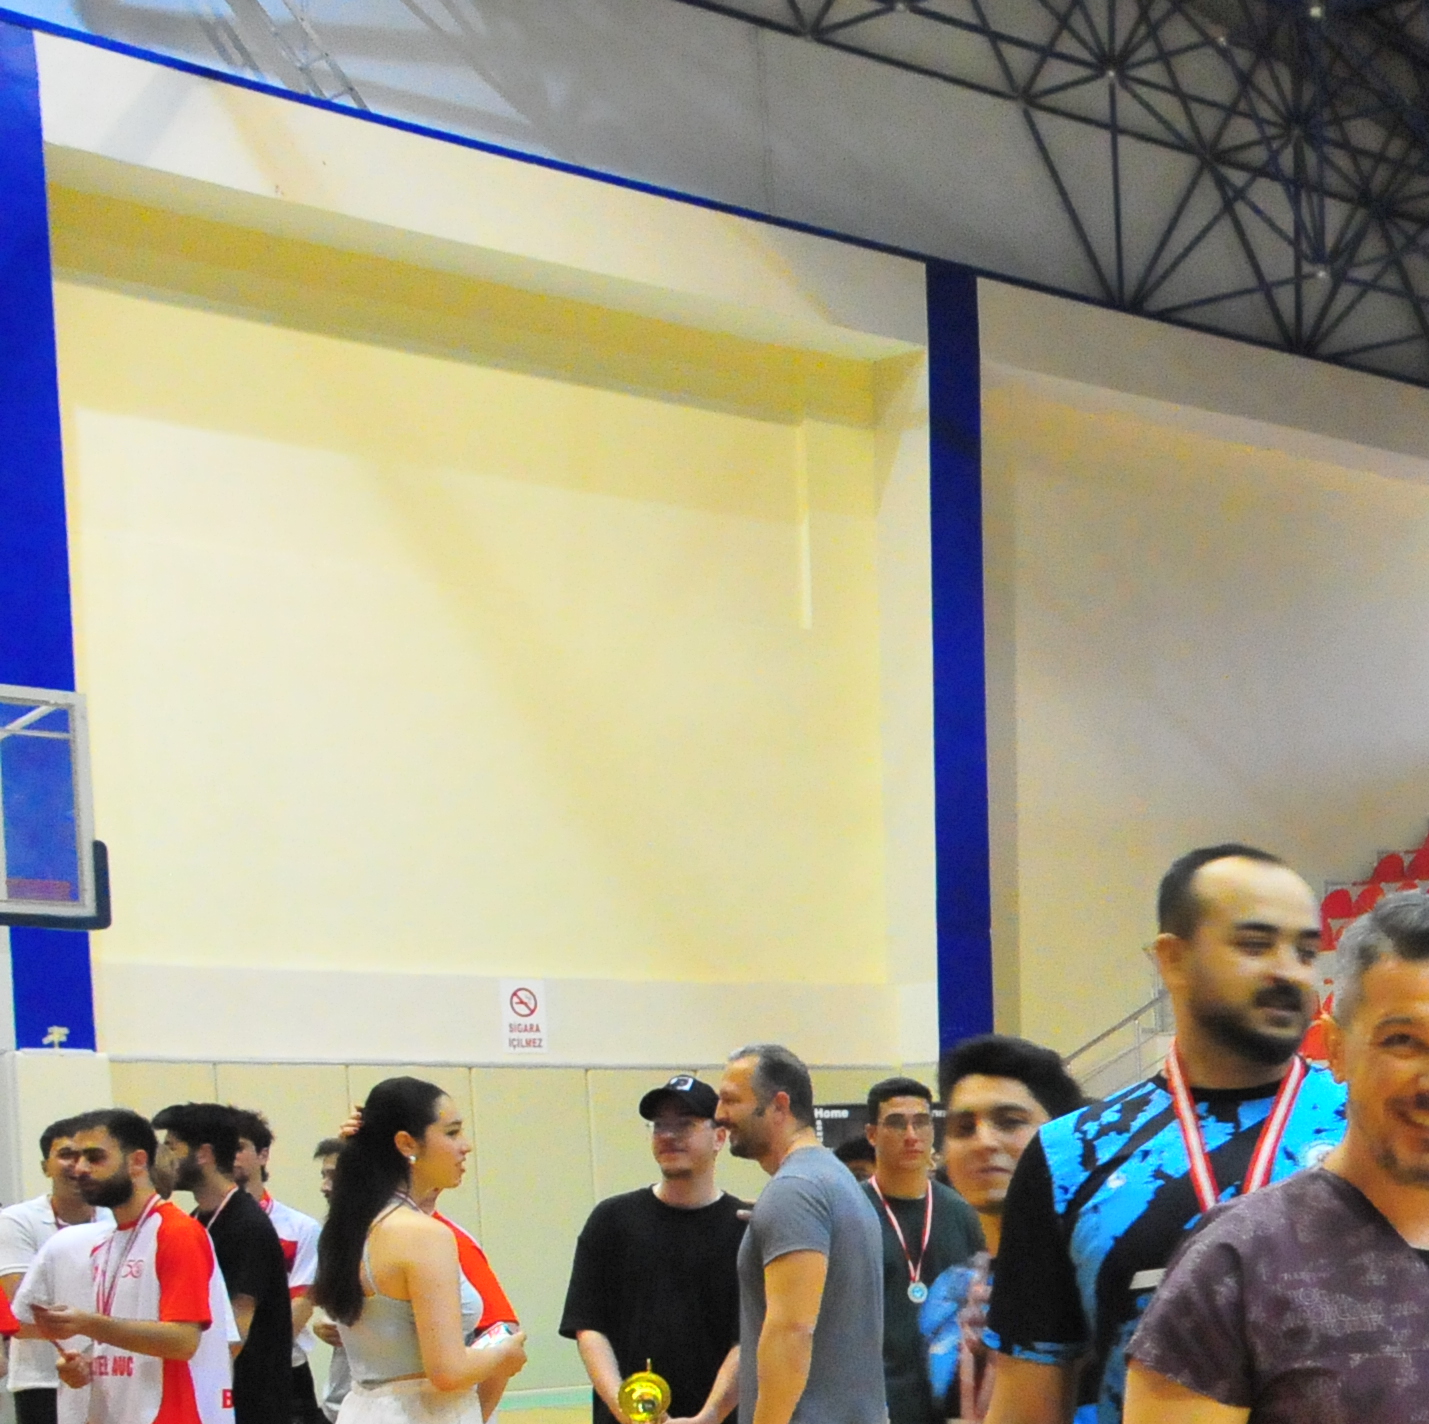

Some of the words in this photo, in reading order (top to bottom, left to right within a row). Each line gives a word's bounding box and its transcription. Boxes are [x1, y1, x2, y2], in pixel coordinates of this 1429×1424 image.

[509, 1023, 540, 1033] SİGARA
[509, 1037, 542, 1049] İÇİLMEZ
[814, 1108, 849, 1119] Home
